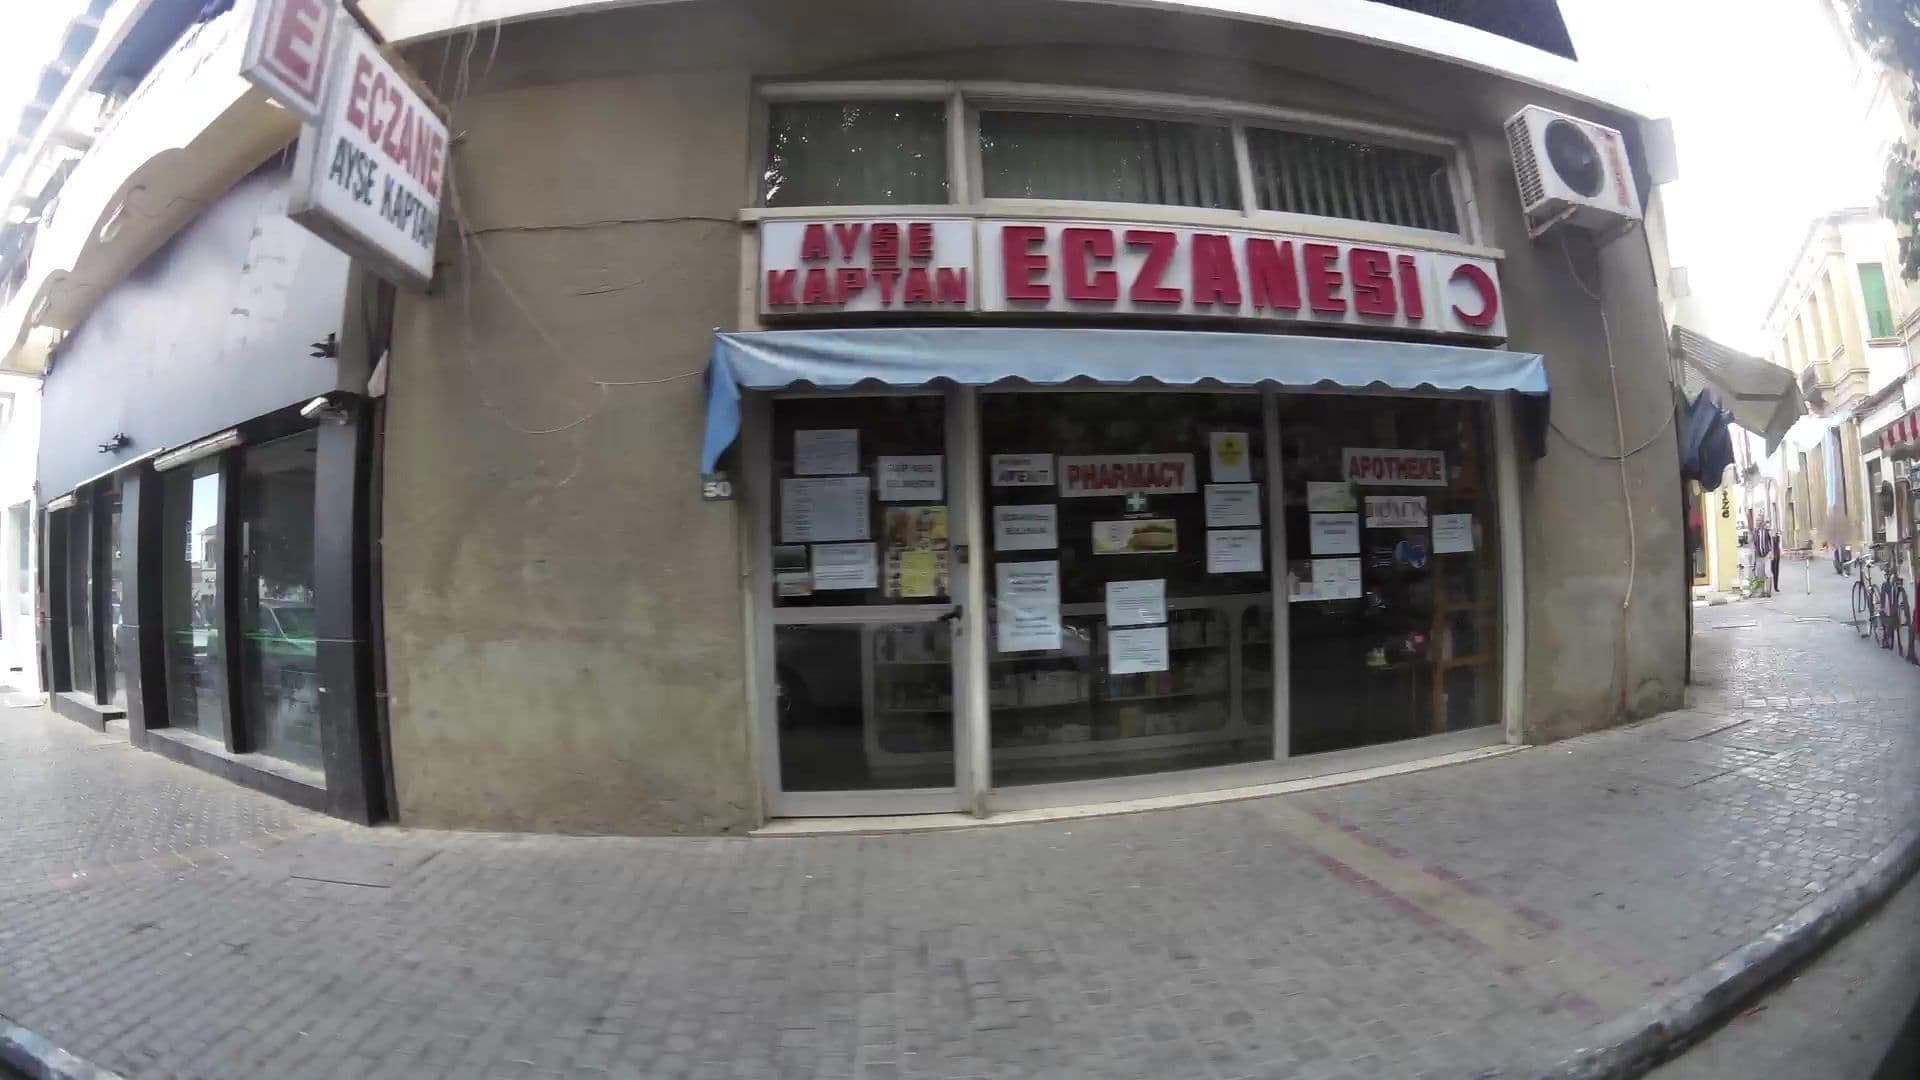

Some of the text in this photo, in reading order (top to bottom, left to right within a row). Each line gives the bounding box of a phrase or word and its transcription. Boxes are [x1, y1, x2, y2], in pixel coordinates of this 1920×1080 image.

[347, 53, 444, 199] ECZANE
[767, 267, 968, 305] KAPTAN
[1066, 462, 1185, 489] PHARMACY
[1350, 456, 1441, 480] APOTHEKE
